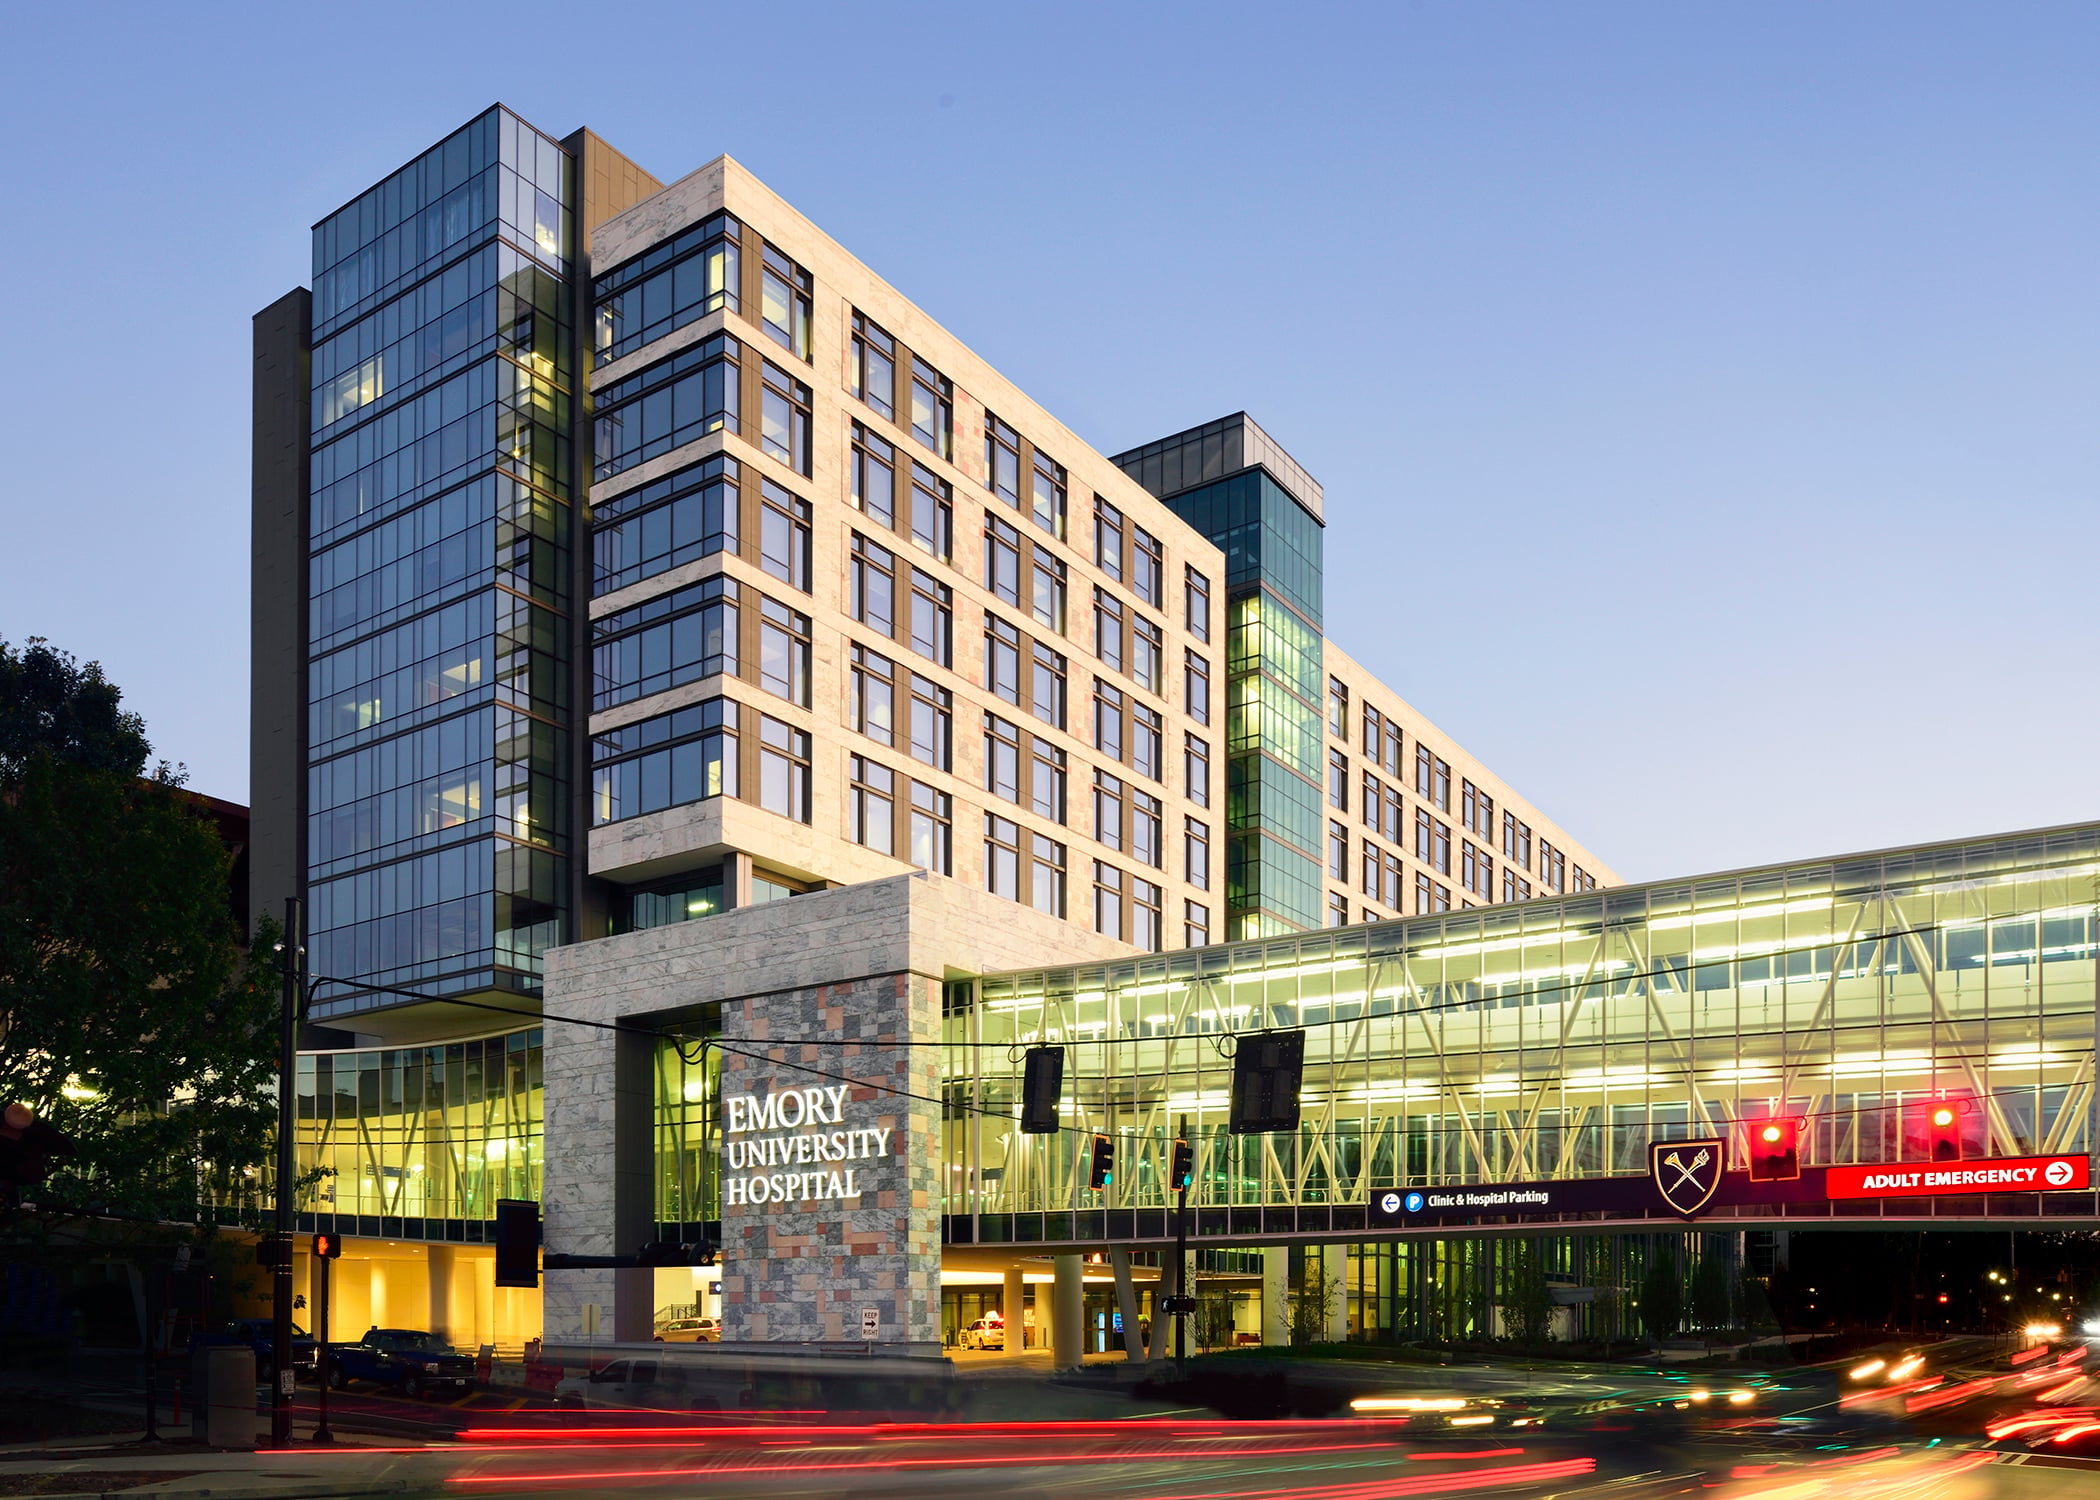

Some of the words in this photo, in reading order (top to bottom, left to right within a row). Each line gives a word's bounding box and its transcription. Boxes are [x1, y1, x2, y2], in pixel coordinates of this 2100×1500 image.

[727, 1085, 848, 1133] EMORY
[727, 1128, 891, 1169] UNIVERSITY
[727, 1170, 862, 1205] HOSPITAL
[1863, 1173, 1921, 1188] ADULT
[1924, 1168, 2037, 1185] EMERGENCY
[1409, 1196, 1419, 1209] P
[1428, 1194, 1455, 1207] Clinic
[1456, 1195, 1465, 1206] &
[1466, 1192, 1507, 1207] Hospital
[1509, 1190, 1548, 1205] Parking
